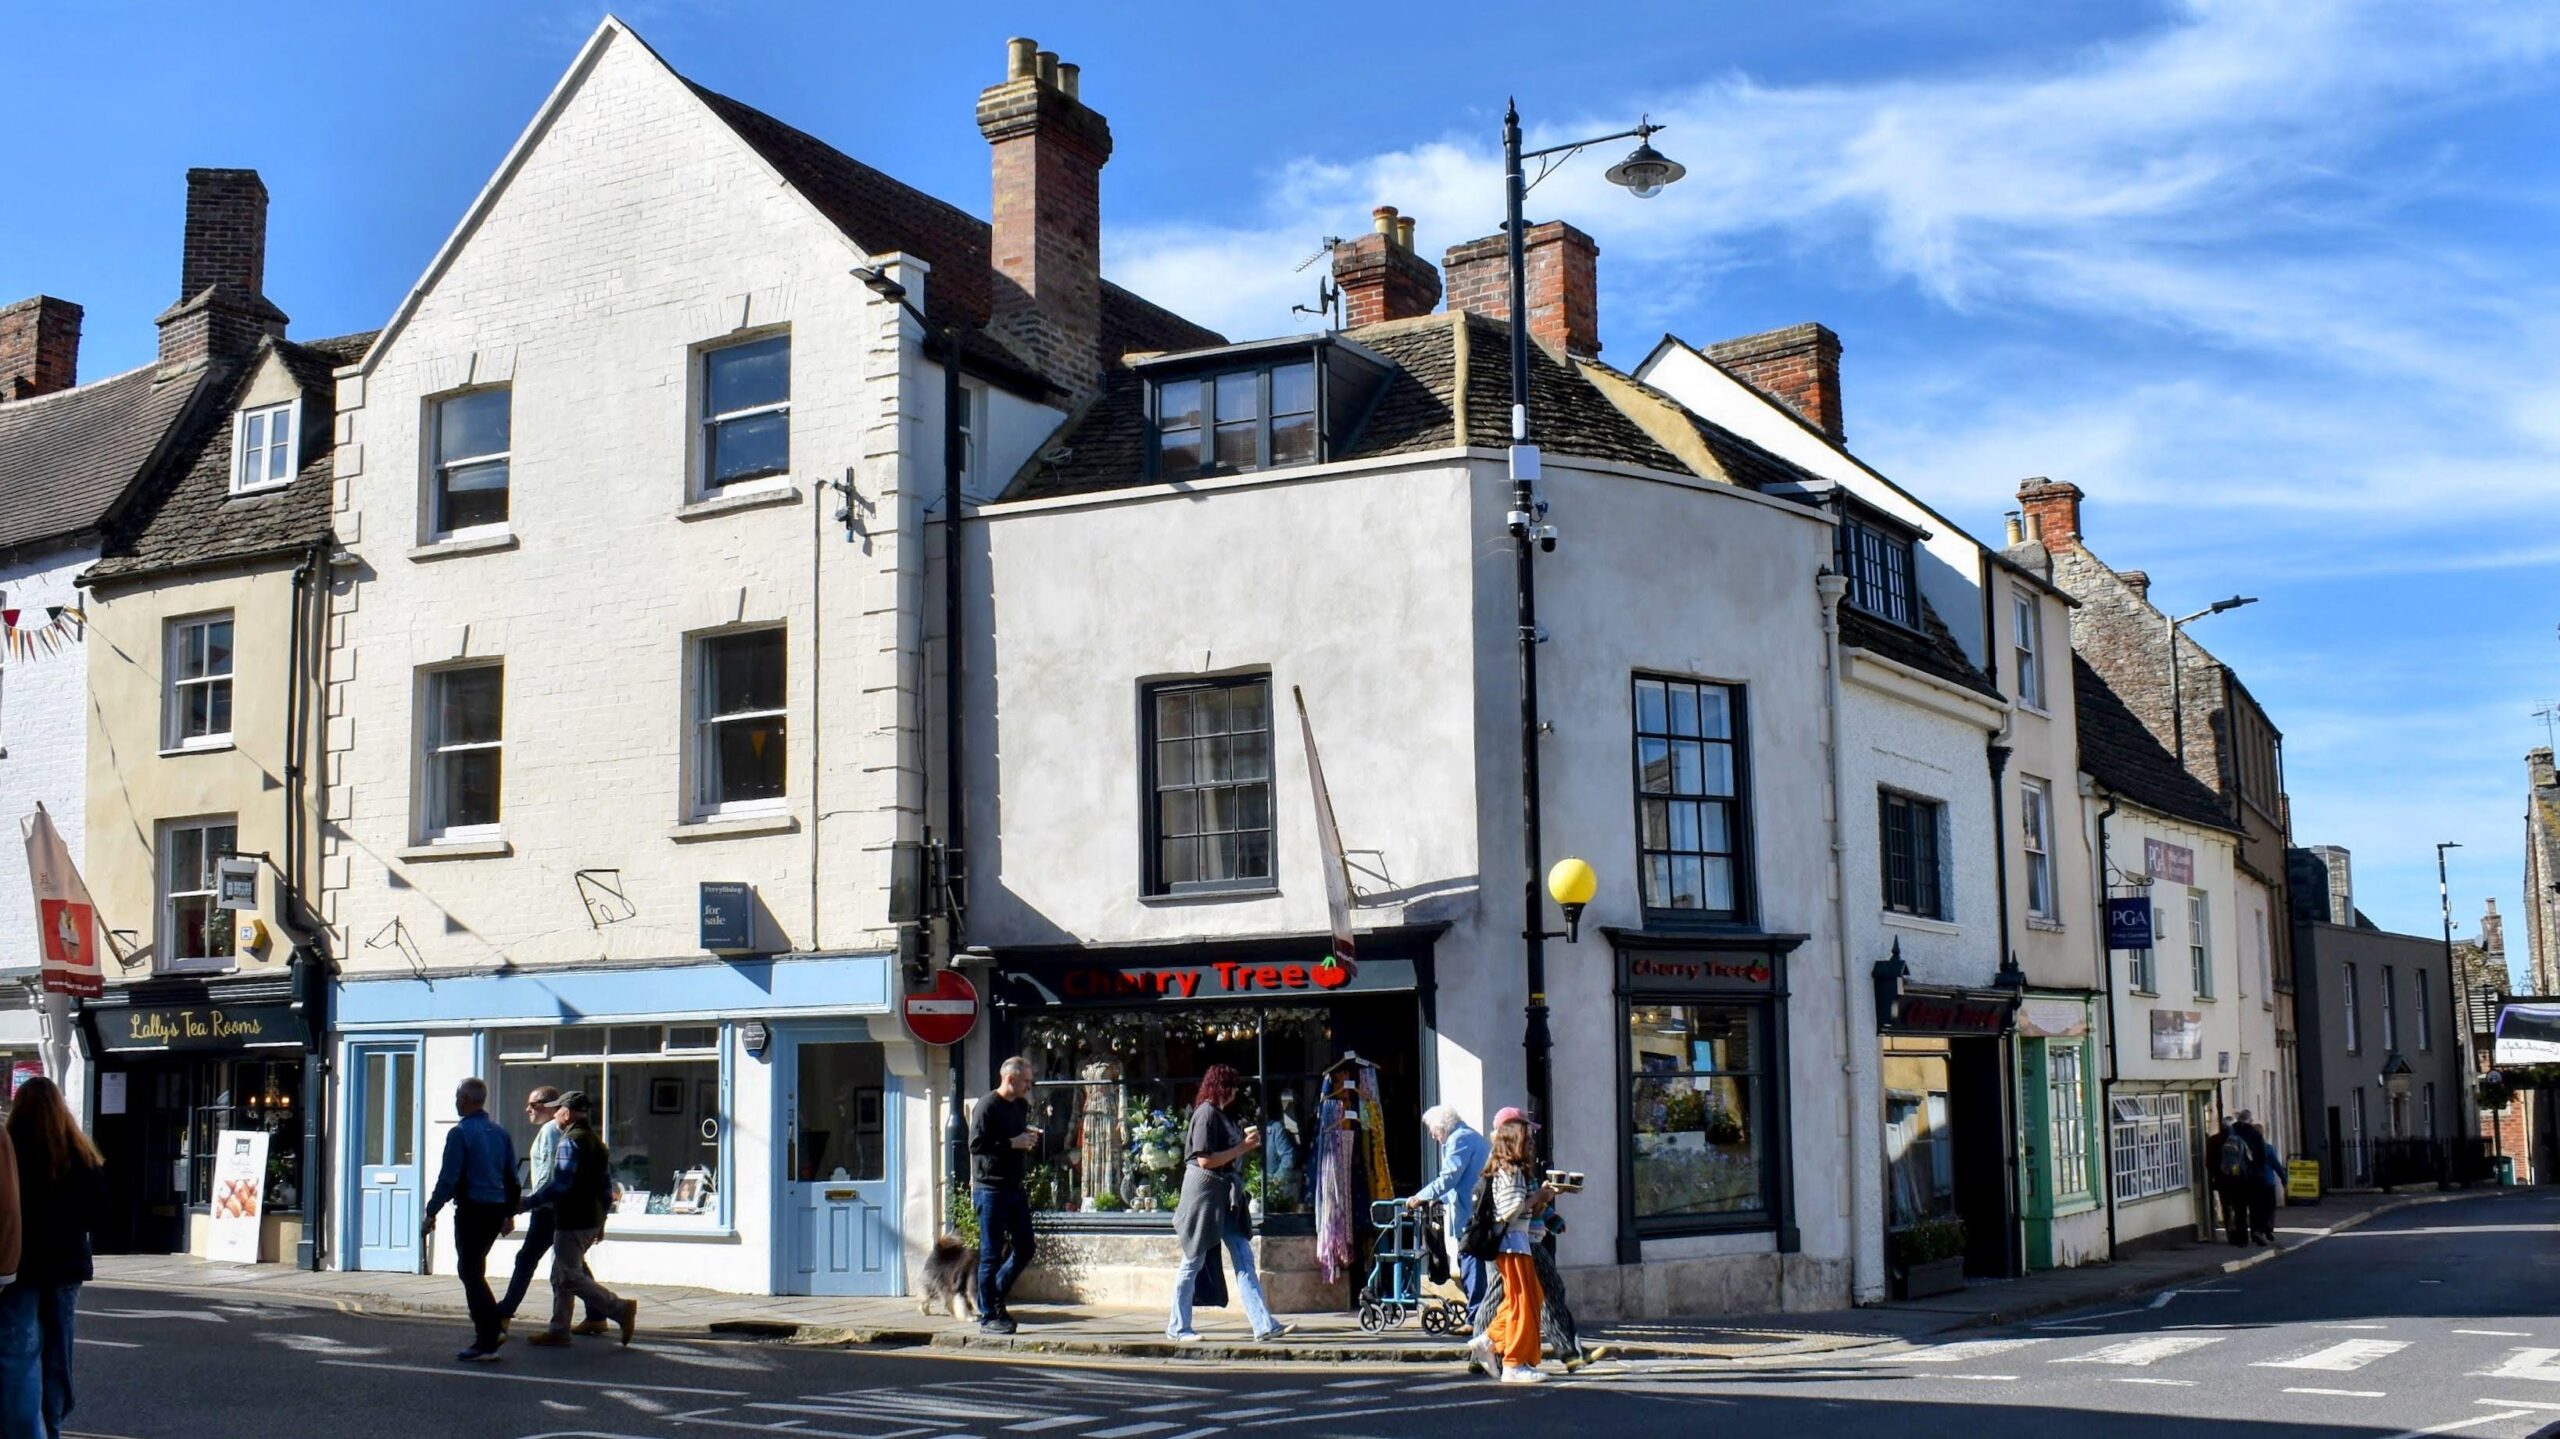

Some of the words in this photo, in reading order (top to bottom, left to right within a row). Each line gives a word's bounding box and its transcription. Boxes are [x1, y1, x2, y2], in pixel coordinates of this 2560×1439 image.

[2148, 845, 2166, 873] PGA
[704, 915, 726, 926] sale
[705, 905, 721, 915] for
[2112, 910, 2148, 926] PGA
[1063, 966, 1198, 998] Cherry
[1211, 961, 1305, 990] Tree
[1632, 959, 1700, 980] Cherry
[1704, 960, 1749, 977] Tree
[130, 1012, 179, 1044] Lally's
[180, 1011, 208, 1037] Tea
[210, 1010, 262, 1037] Rooms
